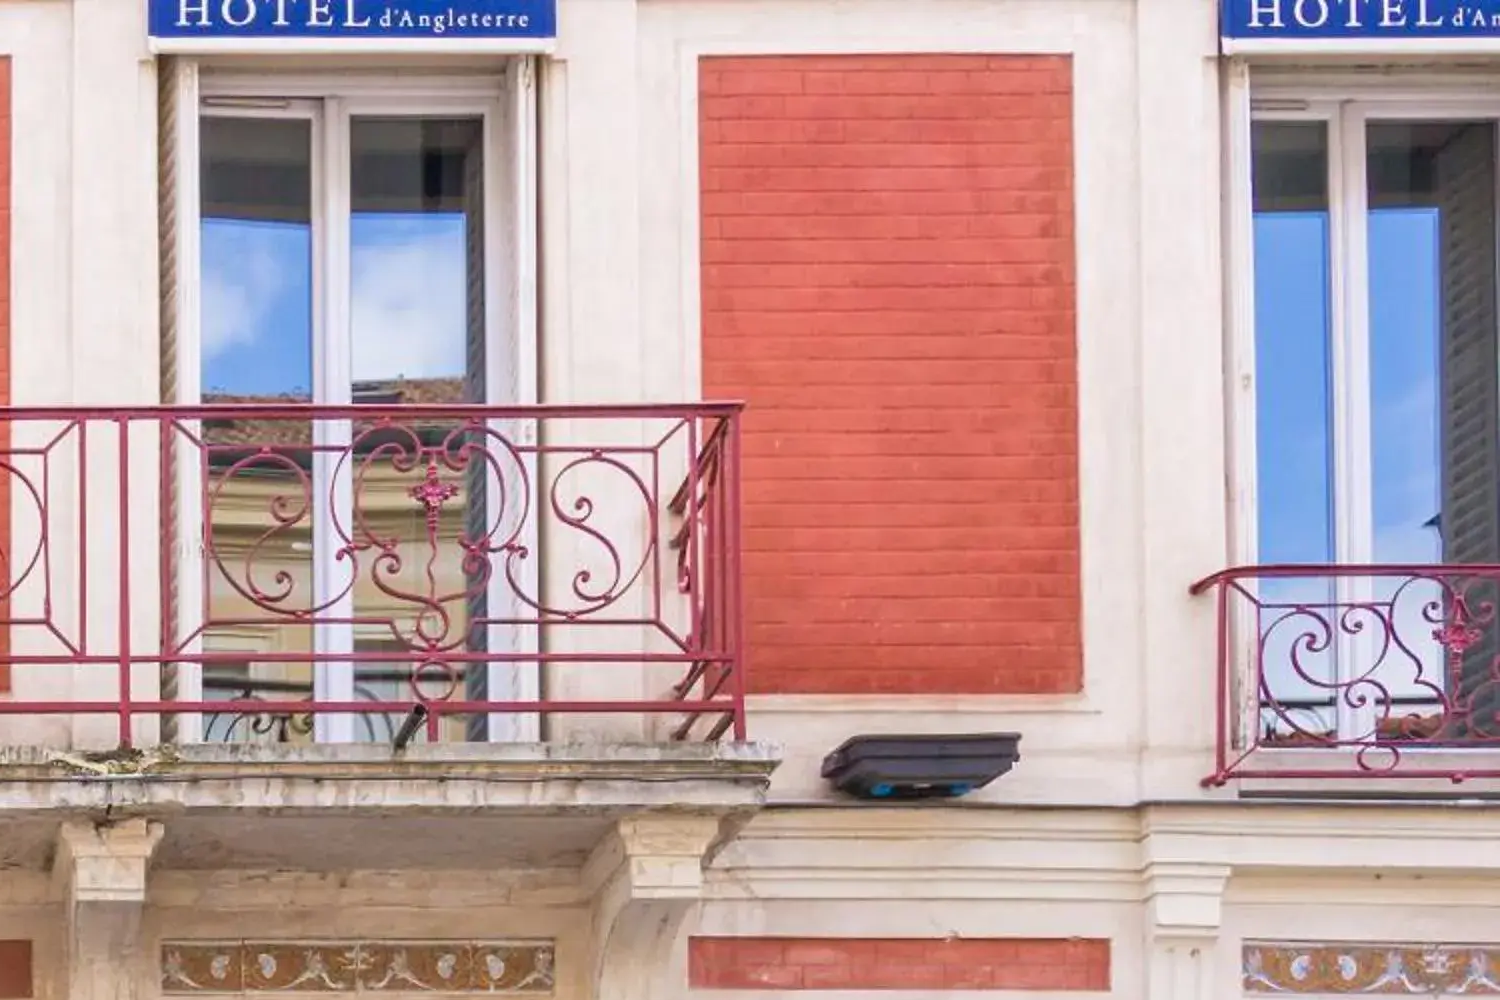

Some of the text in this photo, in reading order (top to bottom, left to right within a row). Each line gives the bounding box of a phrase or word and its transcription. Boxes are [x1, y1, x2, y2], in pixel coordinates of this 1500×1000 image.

[175, 0, 530, 33] HOTEL d'Angleterre
[1247, 0, 1443, 27] HOTEL
